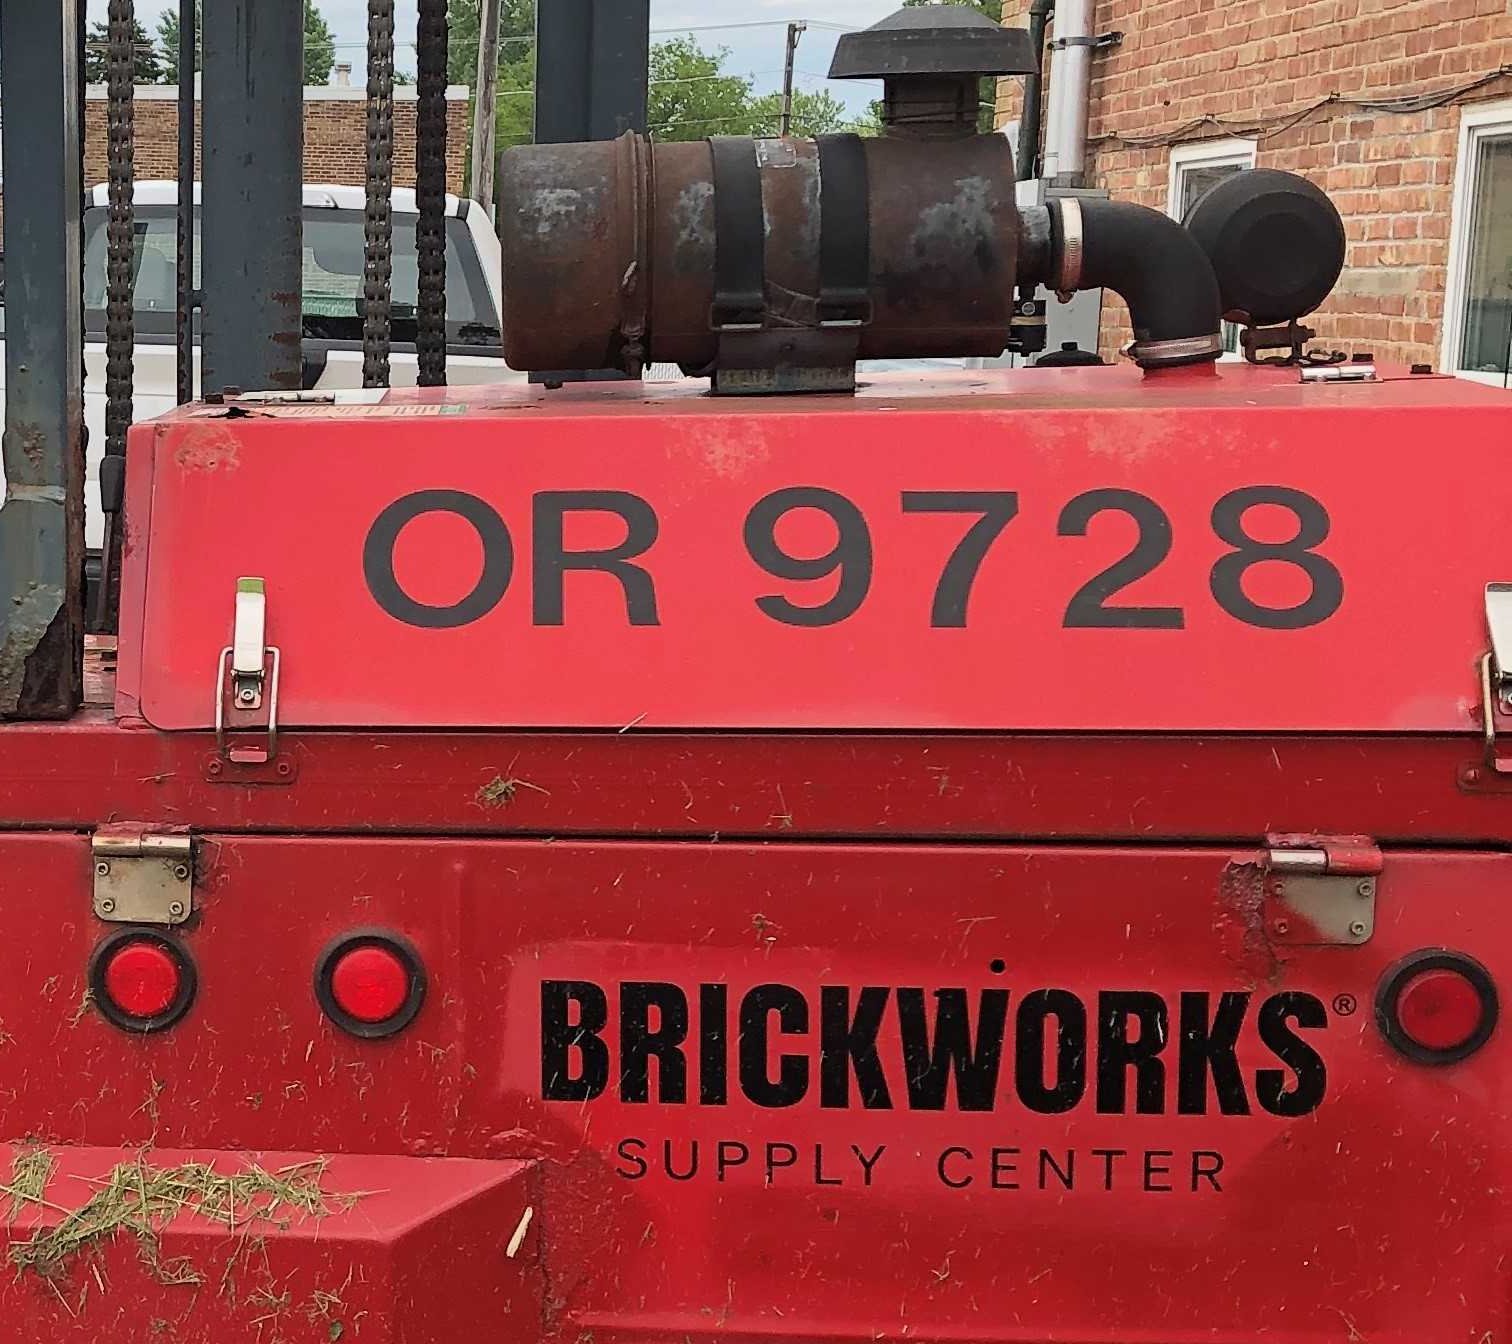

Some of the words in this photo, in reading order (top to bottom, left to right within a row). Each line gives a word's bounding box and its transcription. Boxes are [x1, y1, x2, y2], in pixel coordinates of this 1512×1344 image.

[363, 488, 661, 629] OR
[742, 486, 1345, 631] 9728
[616, 1138, 887, 1186] SUPPLY
[937, 1146, 1224, 1193] CENTER
